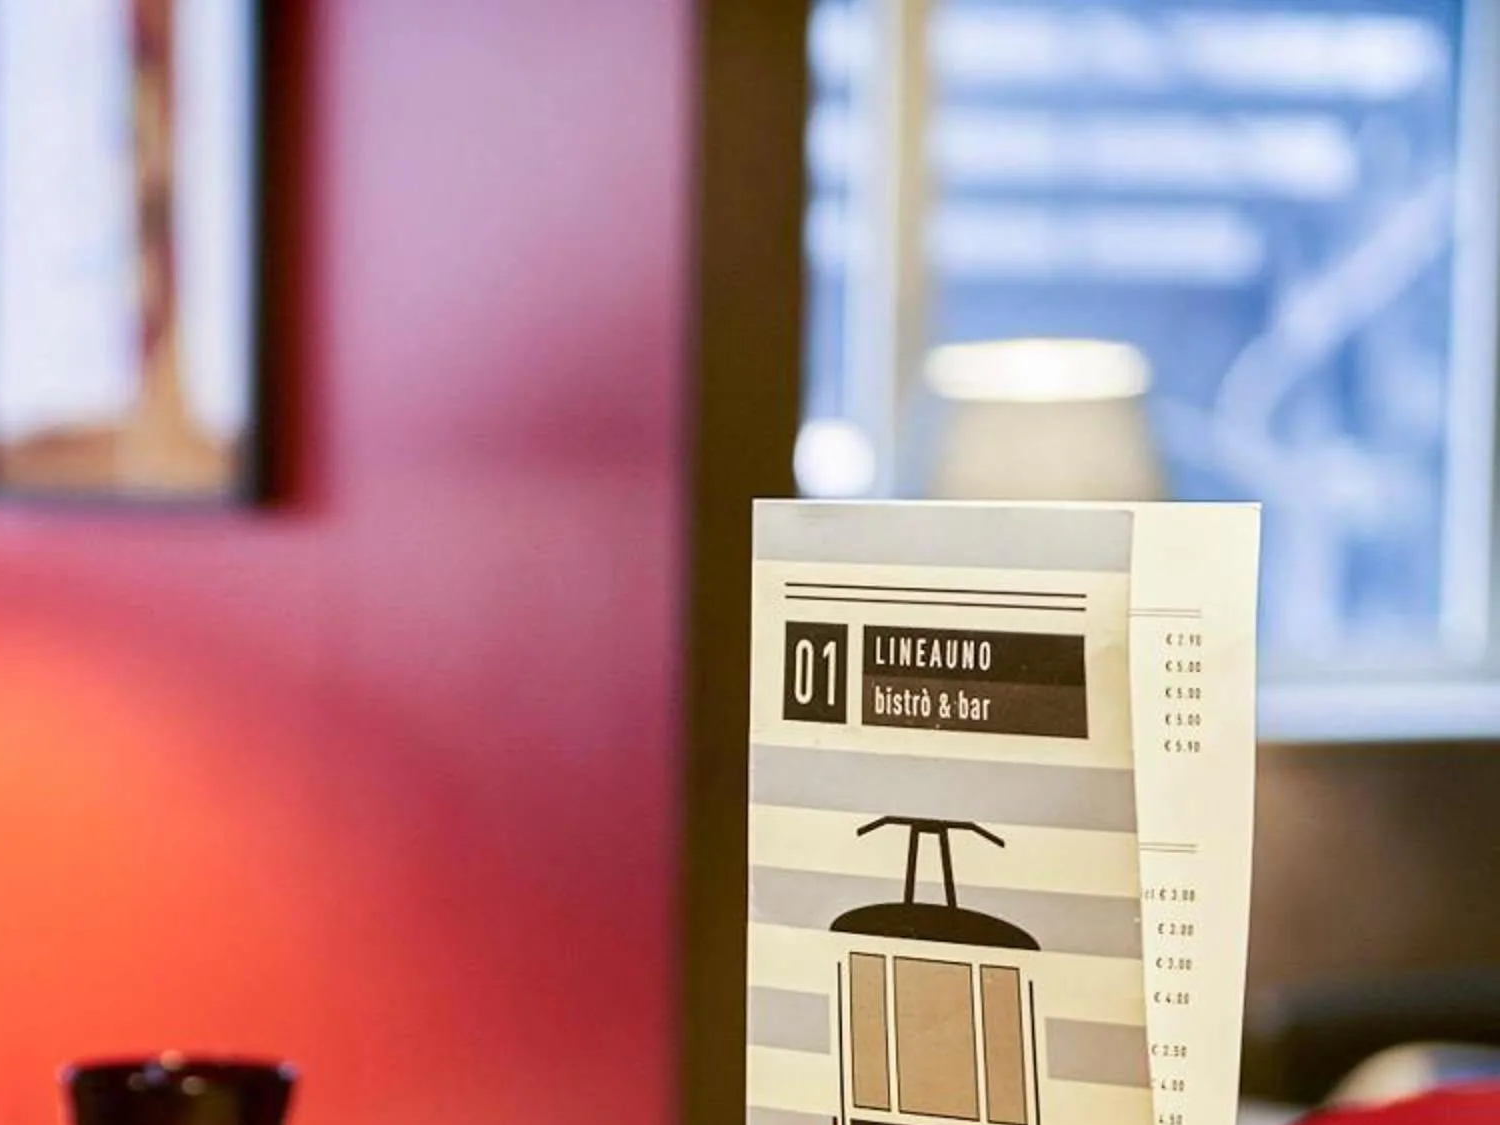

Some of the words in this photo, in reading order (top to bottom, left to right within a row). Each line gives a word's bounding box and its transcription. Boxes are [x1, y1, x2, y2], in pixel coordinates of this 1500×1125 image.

[875, 636, 992, 671] LINEAUNO
[794, 639, 838, 706] 01
[874, 685, 931, 718] bistrò
[938, 692, 952, 719] &
[958, 690, 992, 721] bar
